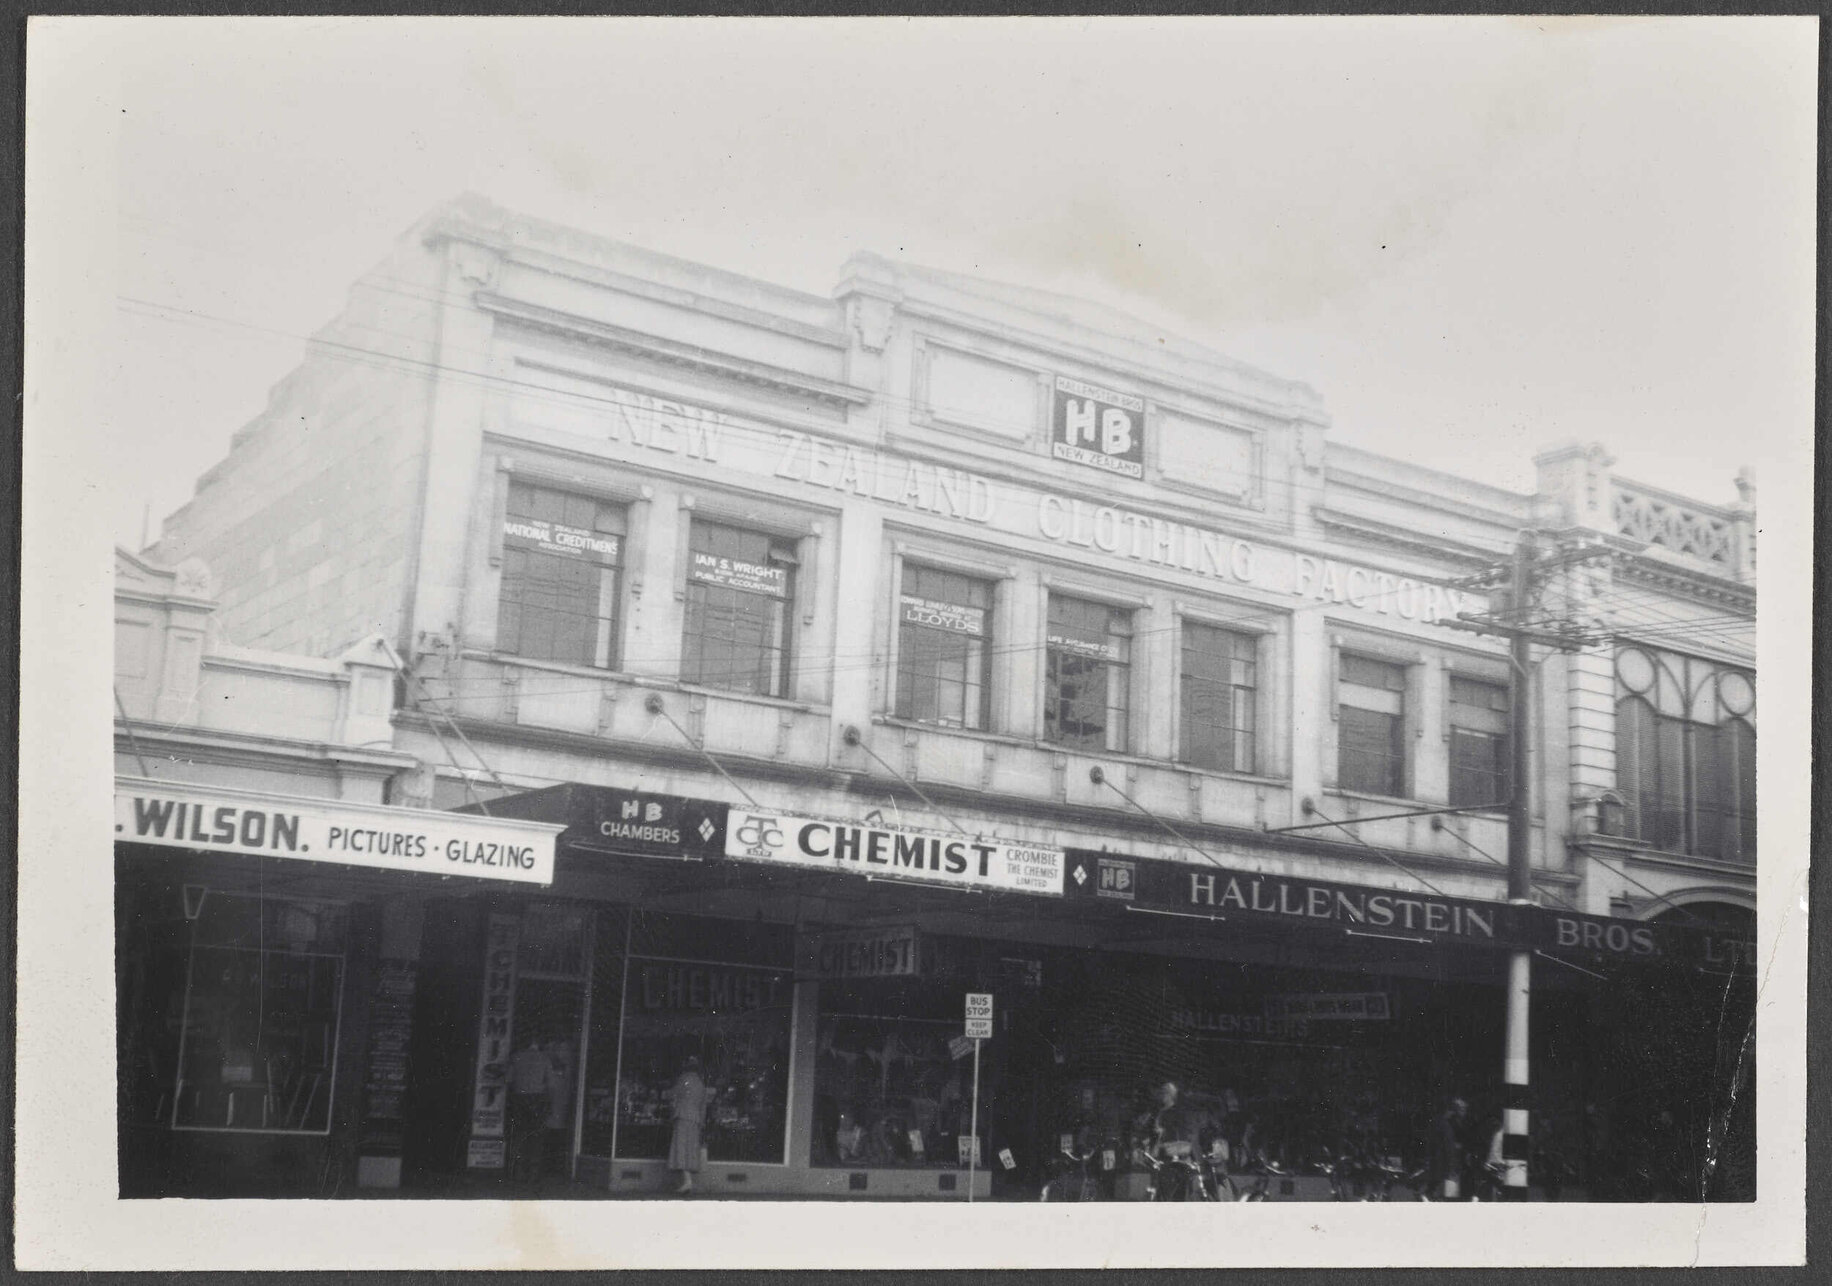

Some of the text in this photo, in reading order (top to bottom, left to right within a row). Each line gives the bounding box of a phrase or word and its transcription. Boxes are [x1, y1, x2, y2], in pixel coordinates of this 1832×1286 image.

[1057, 446, 1140, 476] NEW ZEALAND
[607, 387, 1466, 625] NEW ZEALAND CLOTHING FACTORY
[503, 521, 551, 542] NATIONAL
[695, 554, 716, 568] IAN
[906, 610, 980, 632] LLOYDS
[133, 796, 536, 871] WILSON. PICTURES GLAZING
[600, 821, 680, 844] CHAMBERS
[797, 823, 997, 877] CHEMIST
[1006, 848, 1057, 866] CROMBIE
[1007, 863, 1059, 879] THE CHEMIST
[1016, 876, 1048, 888] LIMITED
[1188, 872, 1495, 938] HALLENSTEIN
[820, 938, 912, 973] CHEMIST
[643, 966, 780, 1009] CHEMIST
[966, 1007, 991, 1016] STOP
[970, 996, 988, 1006] BUS
[481, 950, 513, 1107] CHEMIST
[967, 1028, 989, 1036] CLEAR
